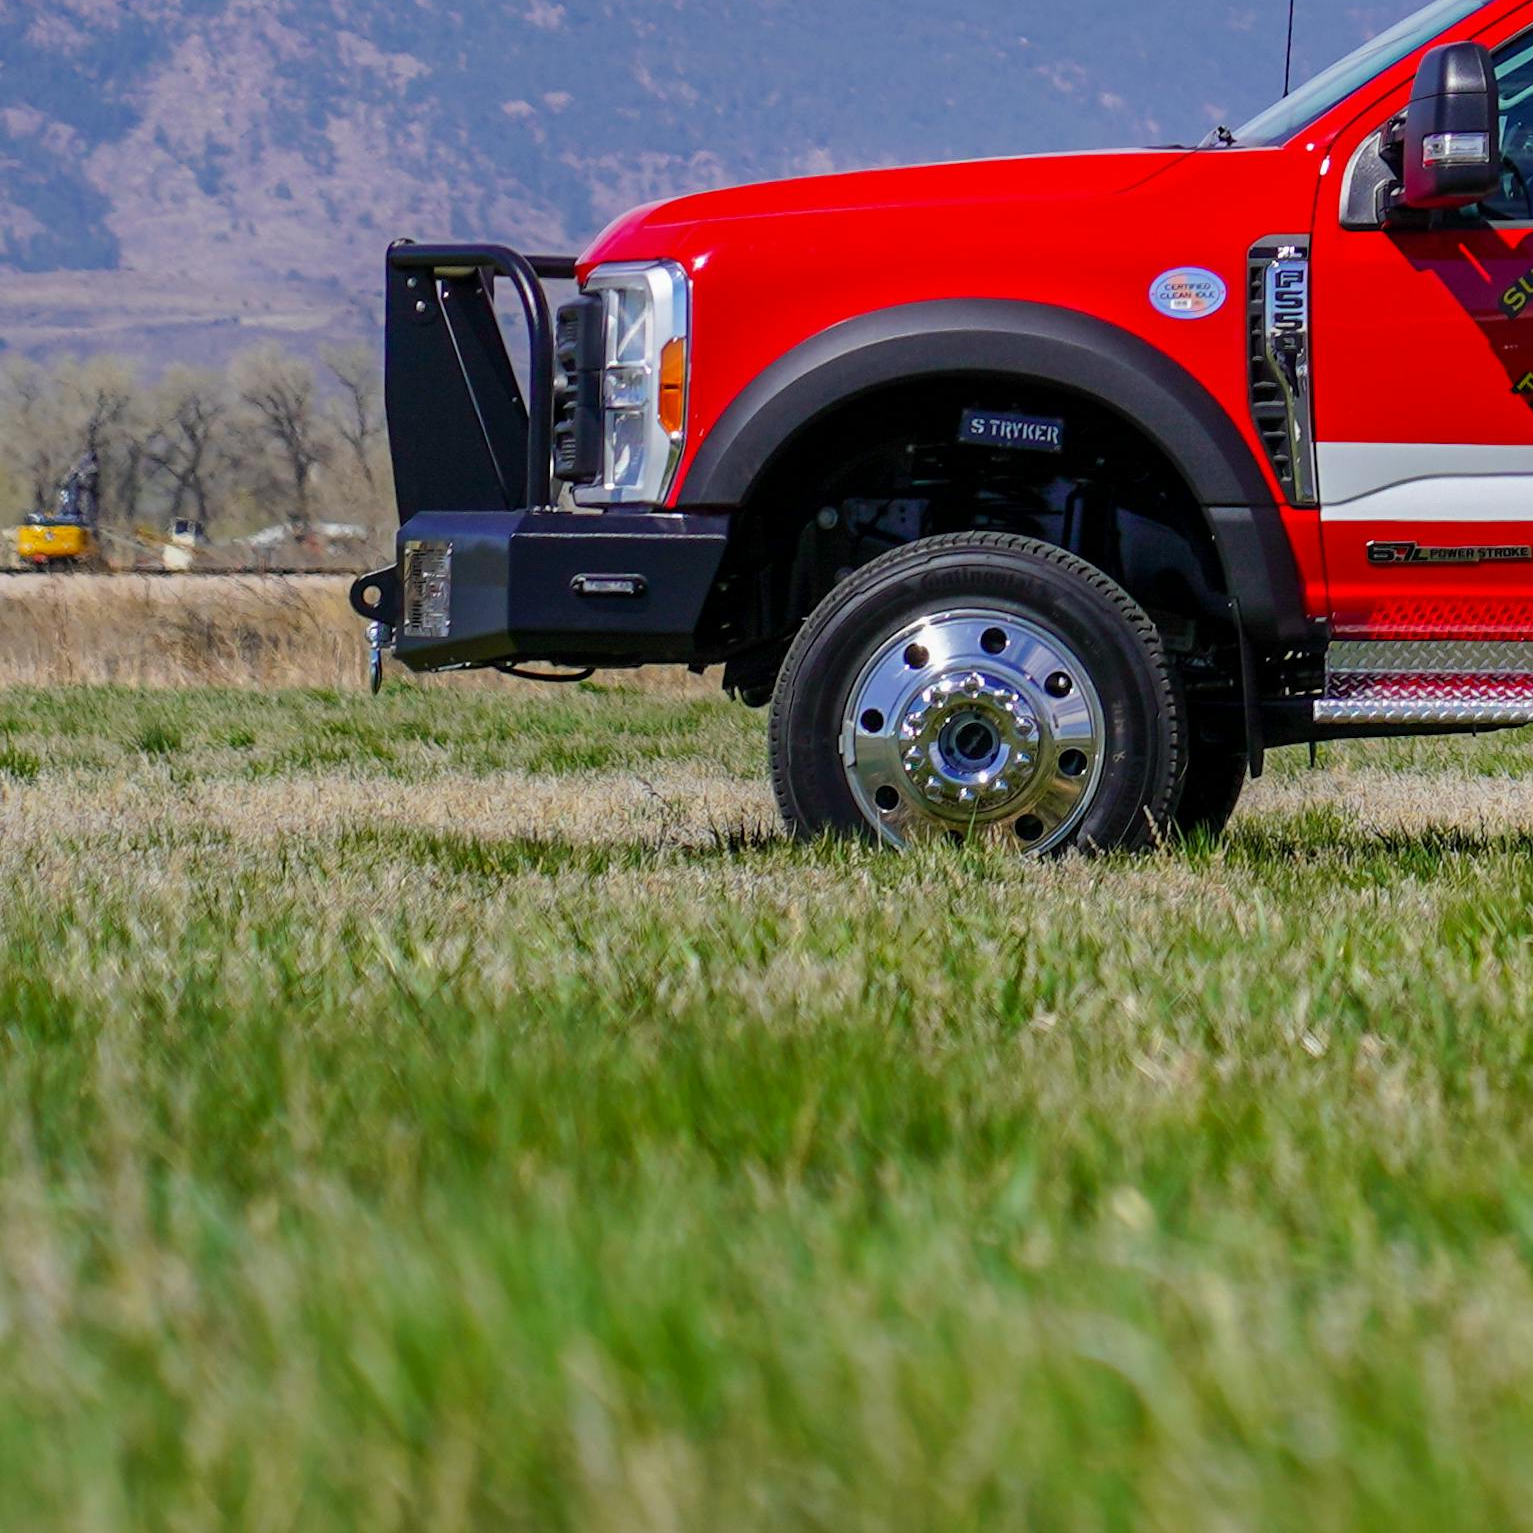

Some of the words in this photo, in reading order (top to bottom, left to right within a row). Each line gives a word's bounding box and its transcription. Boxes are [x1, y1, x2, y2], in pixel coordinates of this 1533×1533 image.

[1163, 282, 1212, 292] CERTIFIED
[1159, 291, 1192, 301] CLEAN
[1430, 547, 1475, 559] POWER
[1478, 546, 1529, 558] STROKE
